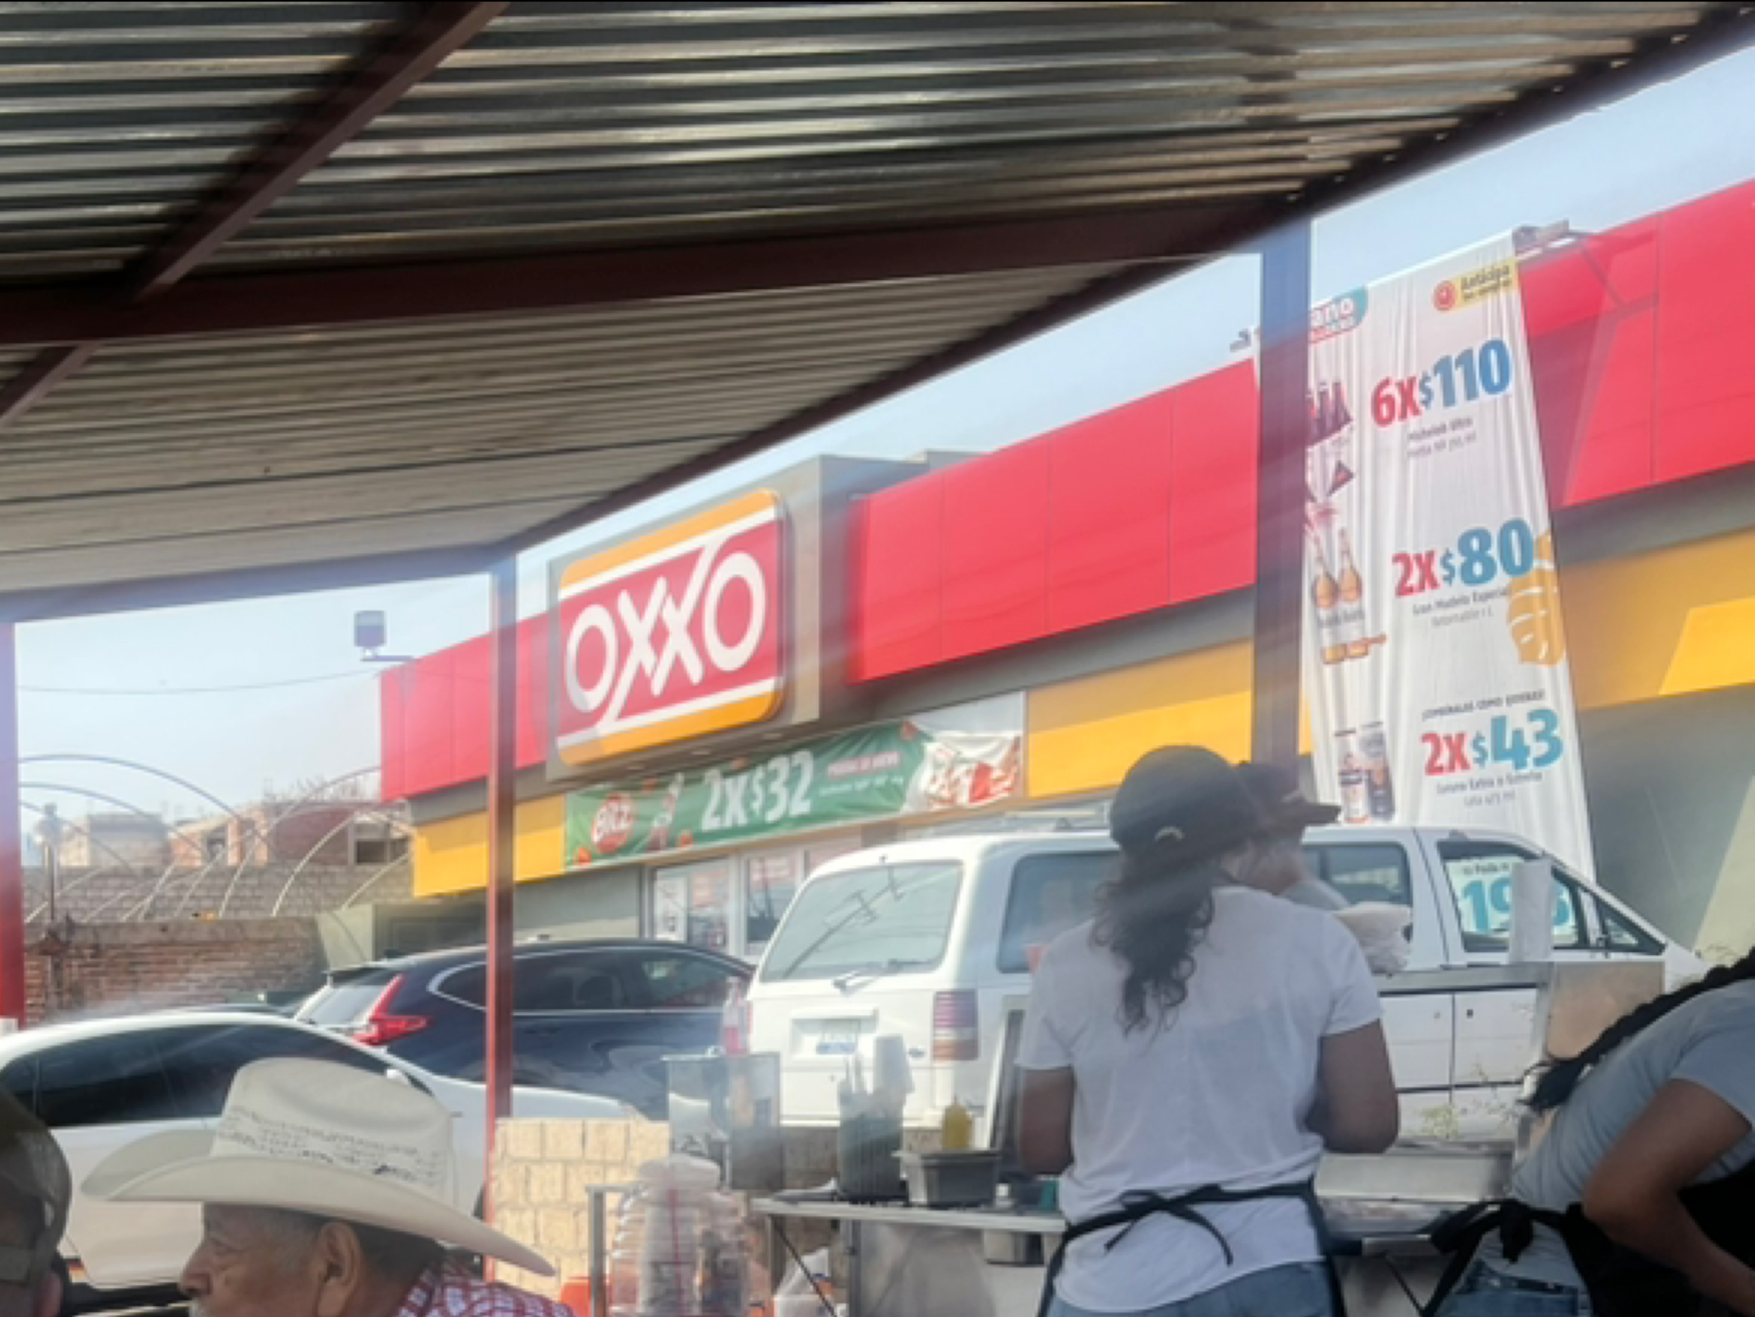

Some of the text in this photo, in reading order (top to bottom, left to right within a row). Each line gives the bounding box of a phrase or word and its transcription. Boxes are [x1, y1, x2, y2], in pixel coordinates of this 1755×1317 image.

[1392, 518, 1534, 596] 2X$80
[566, 548, 766, 722] OXXO
[1421, 708, 1563, 775] 2X$43
